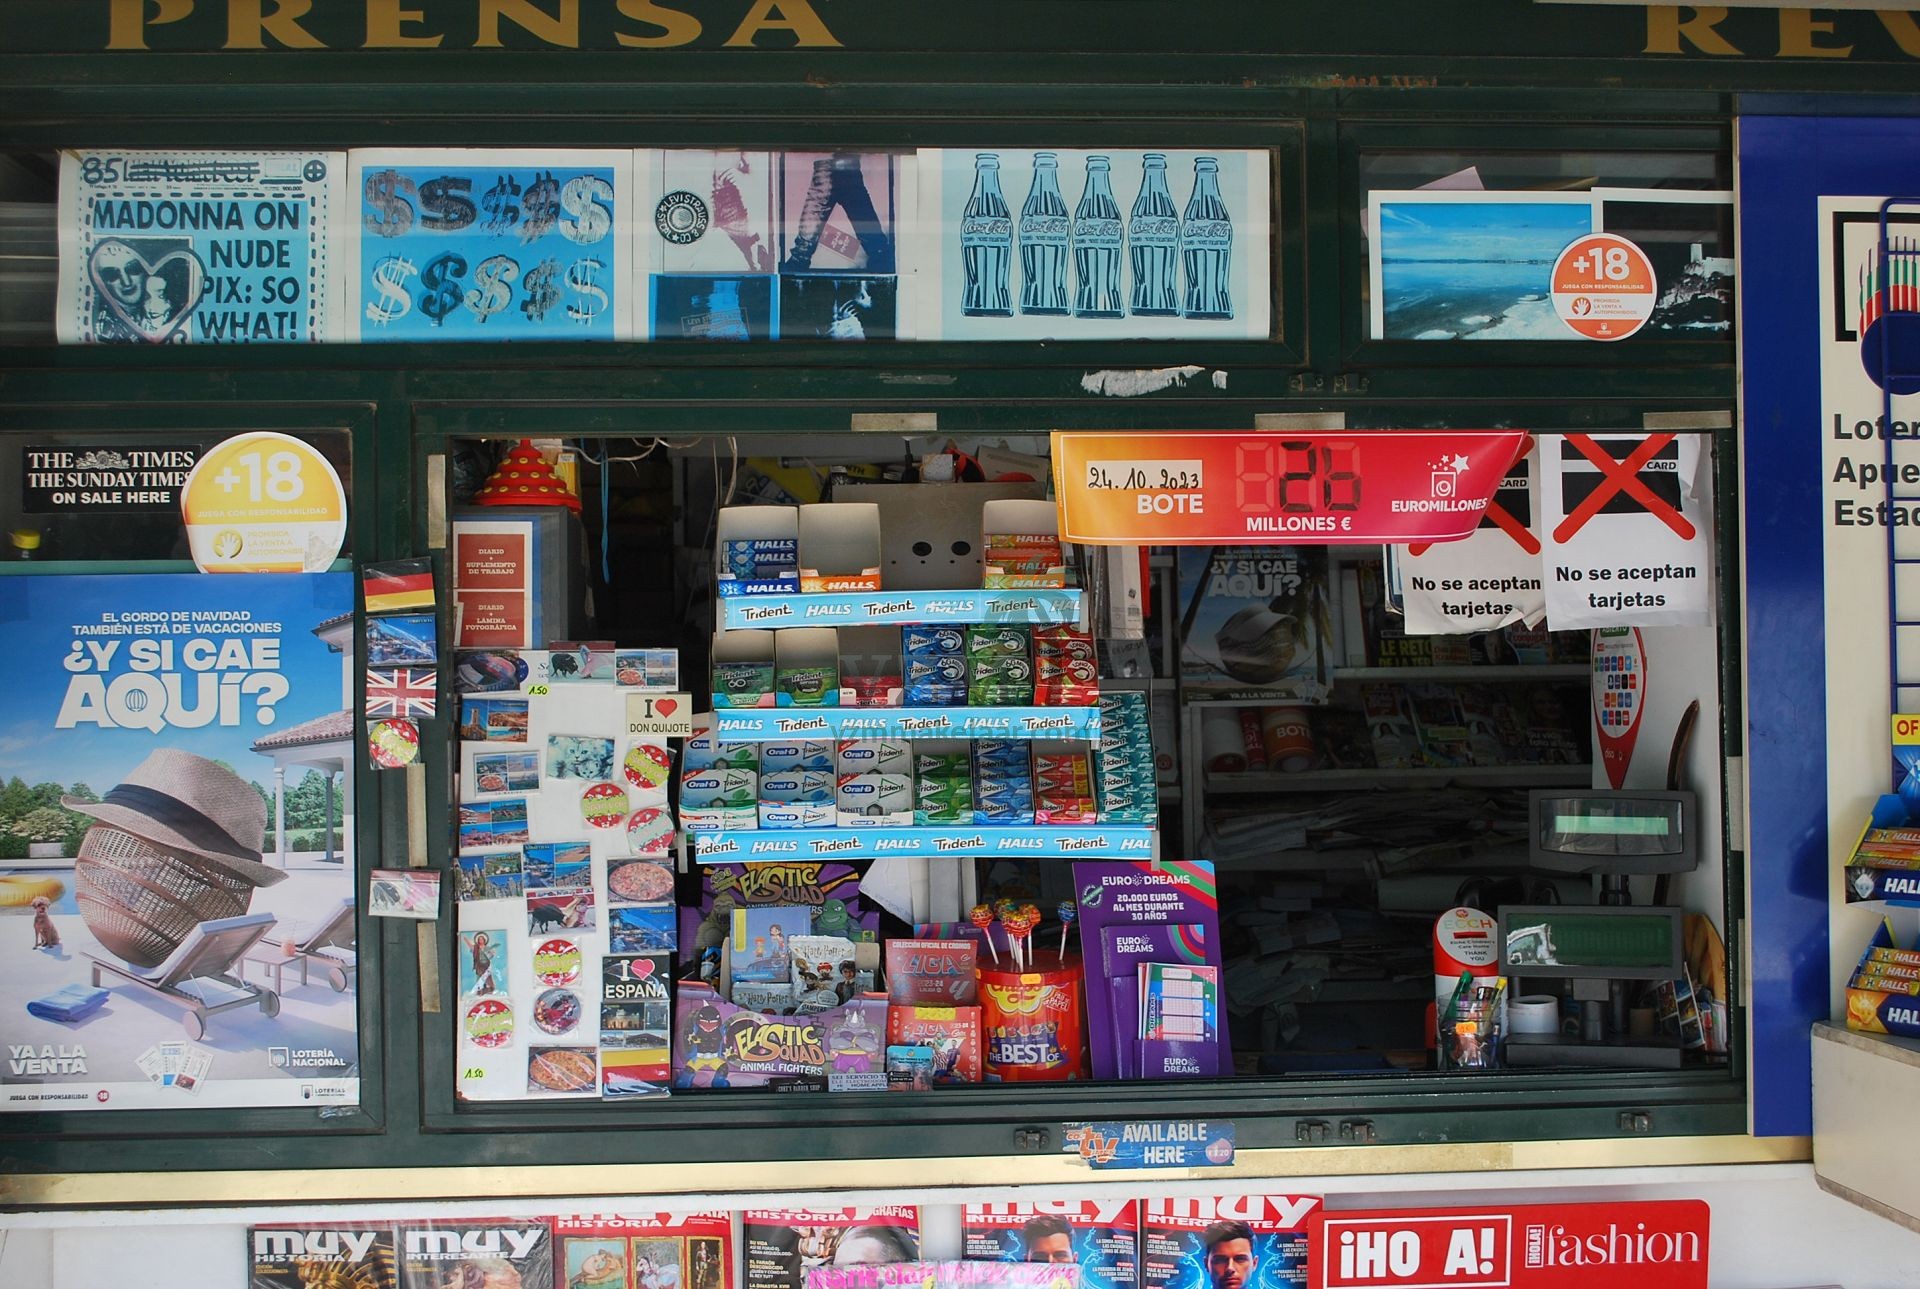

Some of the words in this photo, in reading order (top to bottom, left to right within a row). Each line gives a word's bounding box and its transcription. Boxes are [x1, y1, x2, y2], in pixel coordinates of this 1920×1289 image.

[105, 0, 846, 50] PRENSA
[93, 201, 244, 231] MADONNA
[254, 201, 300, 230] ON
[210, 240, 291, 268] NUDE
[1573, 247, 1630, 281] +18
[200, 276, 252, 304] PIX:
[261, 276, 300, 304] SO
[198, 311, 298, 340] WHAT!
[28, 452, 75, 469] THE
[129, 450, 195, 468] TIMES
[1646, 461, 1677, 471] CARD
[28, 473, 66, 488] THE
[66, 472, 137, 488] SUNDAY
[214, 451, 304, 502] +18
[52, 492, 76, 505] ON
[80, 491, 122, 504] SALE
[126, 491, 171, 504] HERE
[1137, 494, 1204, 514] BOTE
[1391, 496, 1488, 513] EUROMILLONES
[1246, 516, 1337, 532] MILLONES
[1340, 516, 1352, 532] €
[754, 540, 795, 550] HALLS
[1016, 535, 1056, 543] HALLS
[754, 553, 795, 564] HALLS
[1236, 560, 1256, 574] SI
[1258, 560, 1298, 574] CAE
[1556, 566, 1583, 582] No
[1588, 568, 1612, 580] se
[1617, 564, 1696, 582] aceptan
[745, 583, 795, 594] HALLS
[828, 581, 876, 591] HALLS
[1412, 576, 1436, 592] No
[1441, 580, 1463, 592] se
[1468, 576, 1542, 594] aceptan
[1588, 591, 1666, 611] tarjetas
[739, 603, 795, 620] Trident
[805, 604, 851, 617] HALLS
[863, 599, 916, 616] Trident
[986, 598, 1039, 615] Trident
[1441, 601, 1513, 619] tarjetas
[102, 612, 119, 623] EL
[121, 612, 170, 623] GORDO
[172, 611, 190, 622] DE
[192, 611, 251, 622] NAVIDAD
[72, 622, 133, 636] TAMBIÉN
[135, 621, 170, 635] ESTÁ
[172, 624, 192, 634] DE
[194, 622, 282, 635] VACACIONES
[63, 639, 121, 672] ¿Y
[129, 638, 174, 671] SI
[183, 638, 281, 671] CAE
[721, 669, 761, 680] Trident
[907, 665, 937, 675] Trident
[973, 666, 1001, 676] Trident
[1039, 665, 1068, 675] Trident
[644, 699, 653, 719] I
[629, 723, 650, 733] DON
[651, 723, 690, 734] QUIJOTE
[717, 717, 763, 731] HALLS
[775, 714, 829, 732] Trident
[840, 717, 887, 730] HALLS
[898, 713, 953, 732] Trident
[964, 717, 1010, 730] HALLS
[1021, 713, 1075, 731] Trident
[767, 748, 798, 756] Oral-B
[878, 749, 905, 758] Trident
[688, 780, 718, 789] Oral-B
[802, 779, 829, 788] Trident
[843, 785, 873, 794] Oral-B
[751, 841, 798, 854] HALLS
[810, 838, 863, 853] Trident
[875, 839, 921, 850] HALLS
[932, 836, 987, 850] Trident
[997, 838, 1044, 849] HALLS
[1056, 836, 1109, 850] Trident
[1878, 857, 1911, 867] HALLS
[739, 866, 818, 900] ELASTIC
[1102, 876, 1132, 886] EURO
[1143, 875, 1190, 885] DREAMS
[1116, 894, 1148, 902] 20.000
[1149, 893, 1178, 901] EUROS
[1126, 903, 1143, 911] MES
[1144, 902, 1184, 910] DURANTE
[1131, 913, 1143, 921] 30
[1144, 911, 1168, 920] AÑOS
[1116, 937, 1140, 945] EURO
[1117, 944, 1154, 953] DREAMS
[620, 959, 630, 981] I
[901, 954, 964, 975] LIGA
[1887, 968, 1918, 979] HALLS
[605, 979, 668, 999] ESPAÑA
[1878, 979, 1910, 991] HALLS
[734, 1023, 822, 1055] ELASTIC
[8, 1044, 34, 1060] YA
[37, 1044, 52, 1059] A
[58, 1044, 88, 1059] LA
[291, 1048, 335, 1058] LOTERÍA
[989, 1052, 1002, 1062] THE
[1001, 1044, 1050, 1064] BEST
[1047, 1054, 1060, 1062] OF
[9, 1058, 88, 1076] VENTA
[292, 1058, 346, 1067] NACIONAL
[1163, 1057, 1187, 1065] EURO
[740, 1062, 777, 1072] ANIMAL
[779, 1063, 824, 1076] FIGHTERS
[1163, 1065, 1200, 1074] DREAMS
[40, 1094, 89, 1102] RESPONSABILIDAD
[1122, 1123, 1207, 1143] AVAILABLE
[1144, 1145, 1186, 1165] HERE
[747, 1210, 850, 1222] HISTORIA
[1148, 1196, 1320, 1229] muy
[558, 1219, 663, 1229] HISTORIA
[254, 1230, 377, 1262] muy
[405, 1229, 544, 1259] muy
[1545, 1222, 1700, 1267] fashion
[255, 1253, 345, 1263] HISTORIA
[406, 1251, 510, 1261] INTERESANTE
